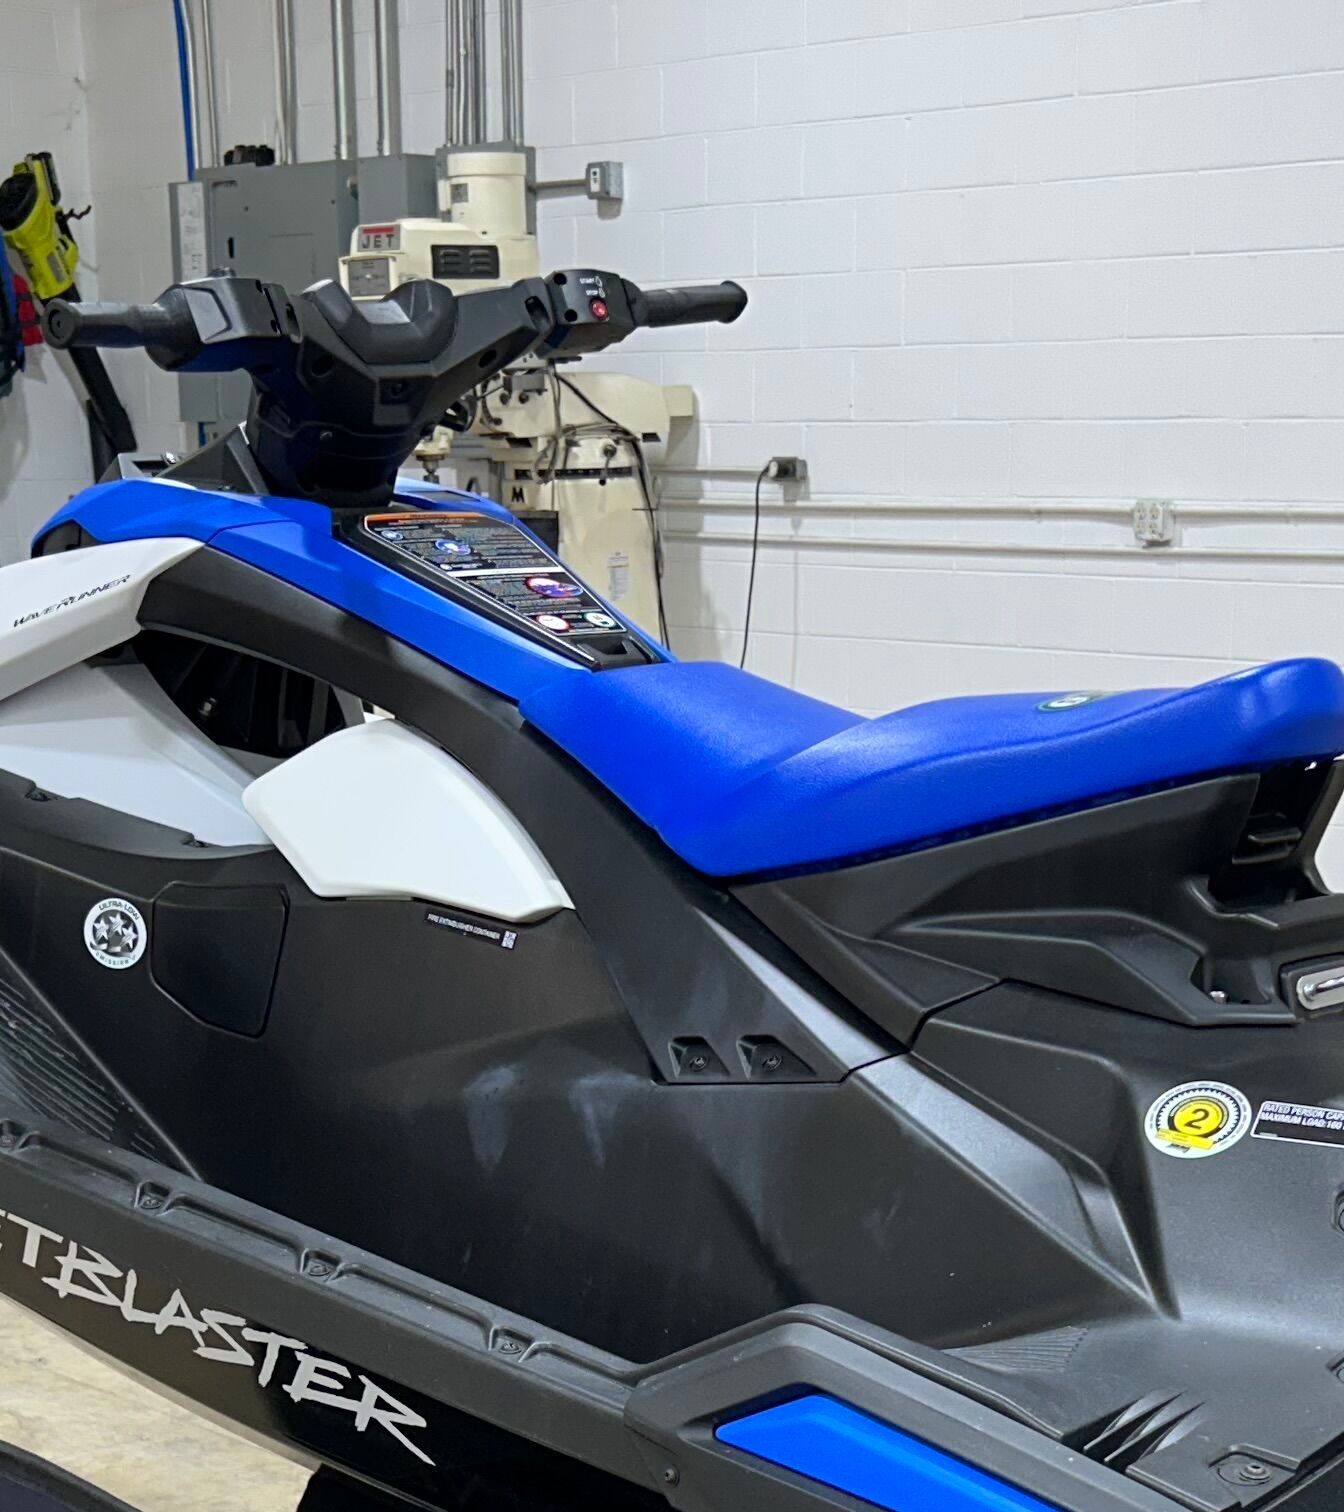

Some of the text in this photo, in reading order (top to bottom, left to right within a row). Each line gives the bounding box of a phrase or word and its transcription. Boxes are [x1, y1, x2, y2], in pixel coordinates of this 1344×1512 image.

[362, 234, 394, 249] JET
[1264, 1103, 1290, 1115] RATED
[1290, 1106, 1325, 1118] PERSON
[1184, 1108, 1210, 1130] 2
[1260, 1112, 1302, 1125] MAXIMUM
